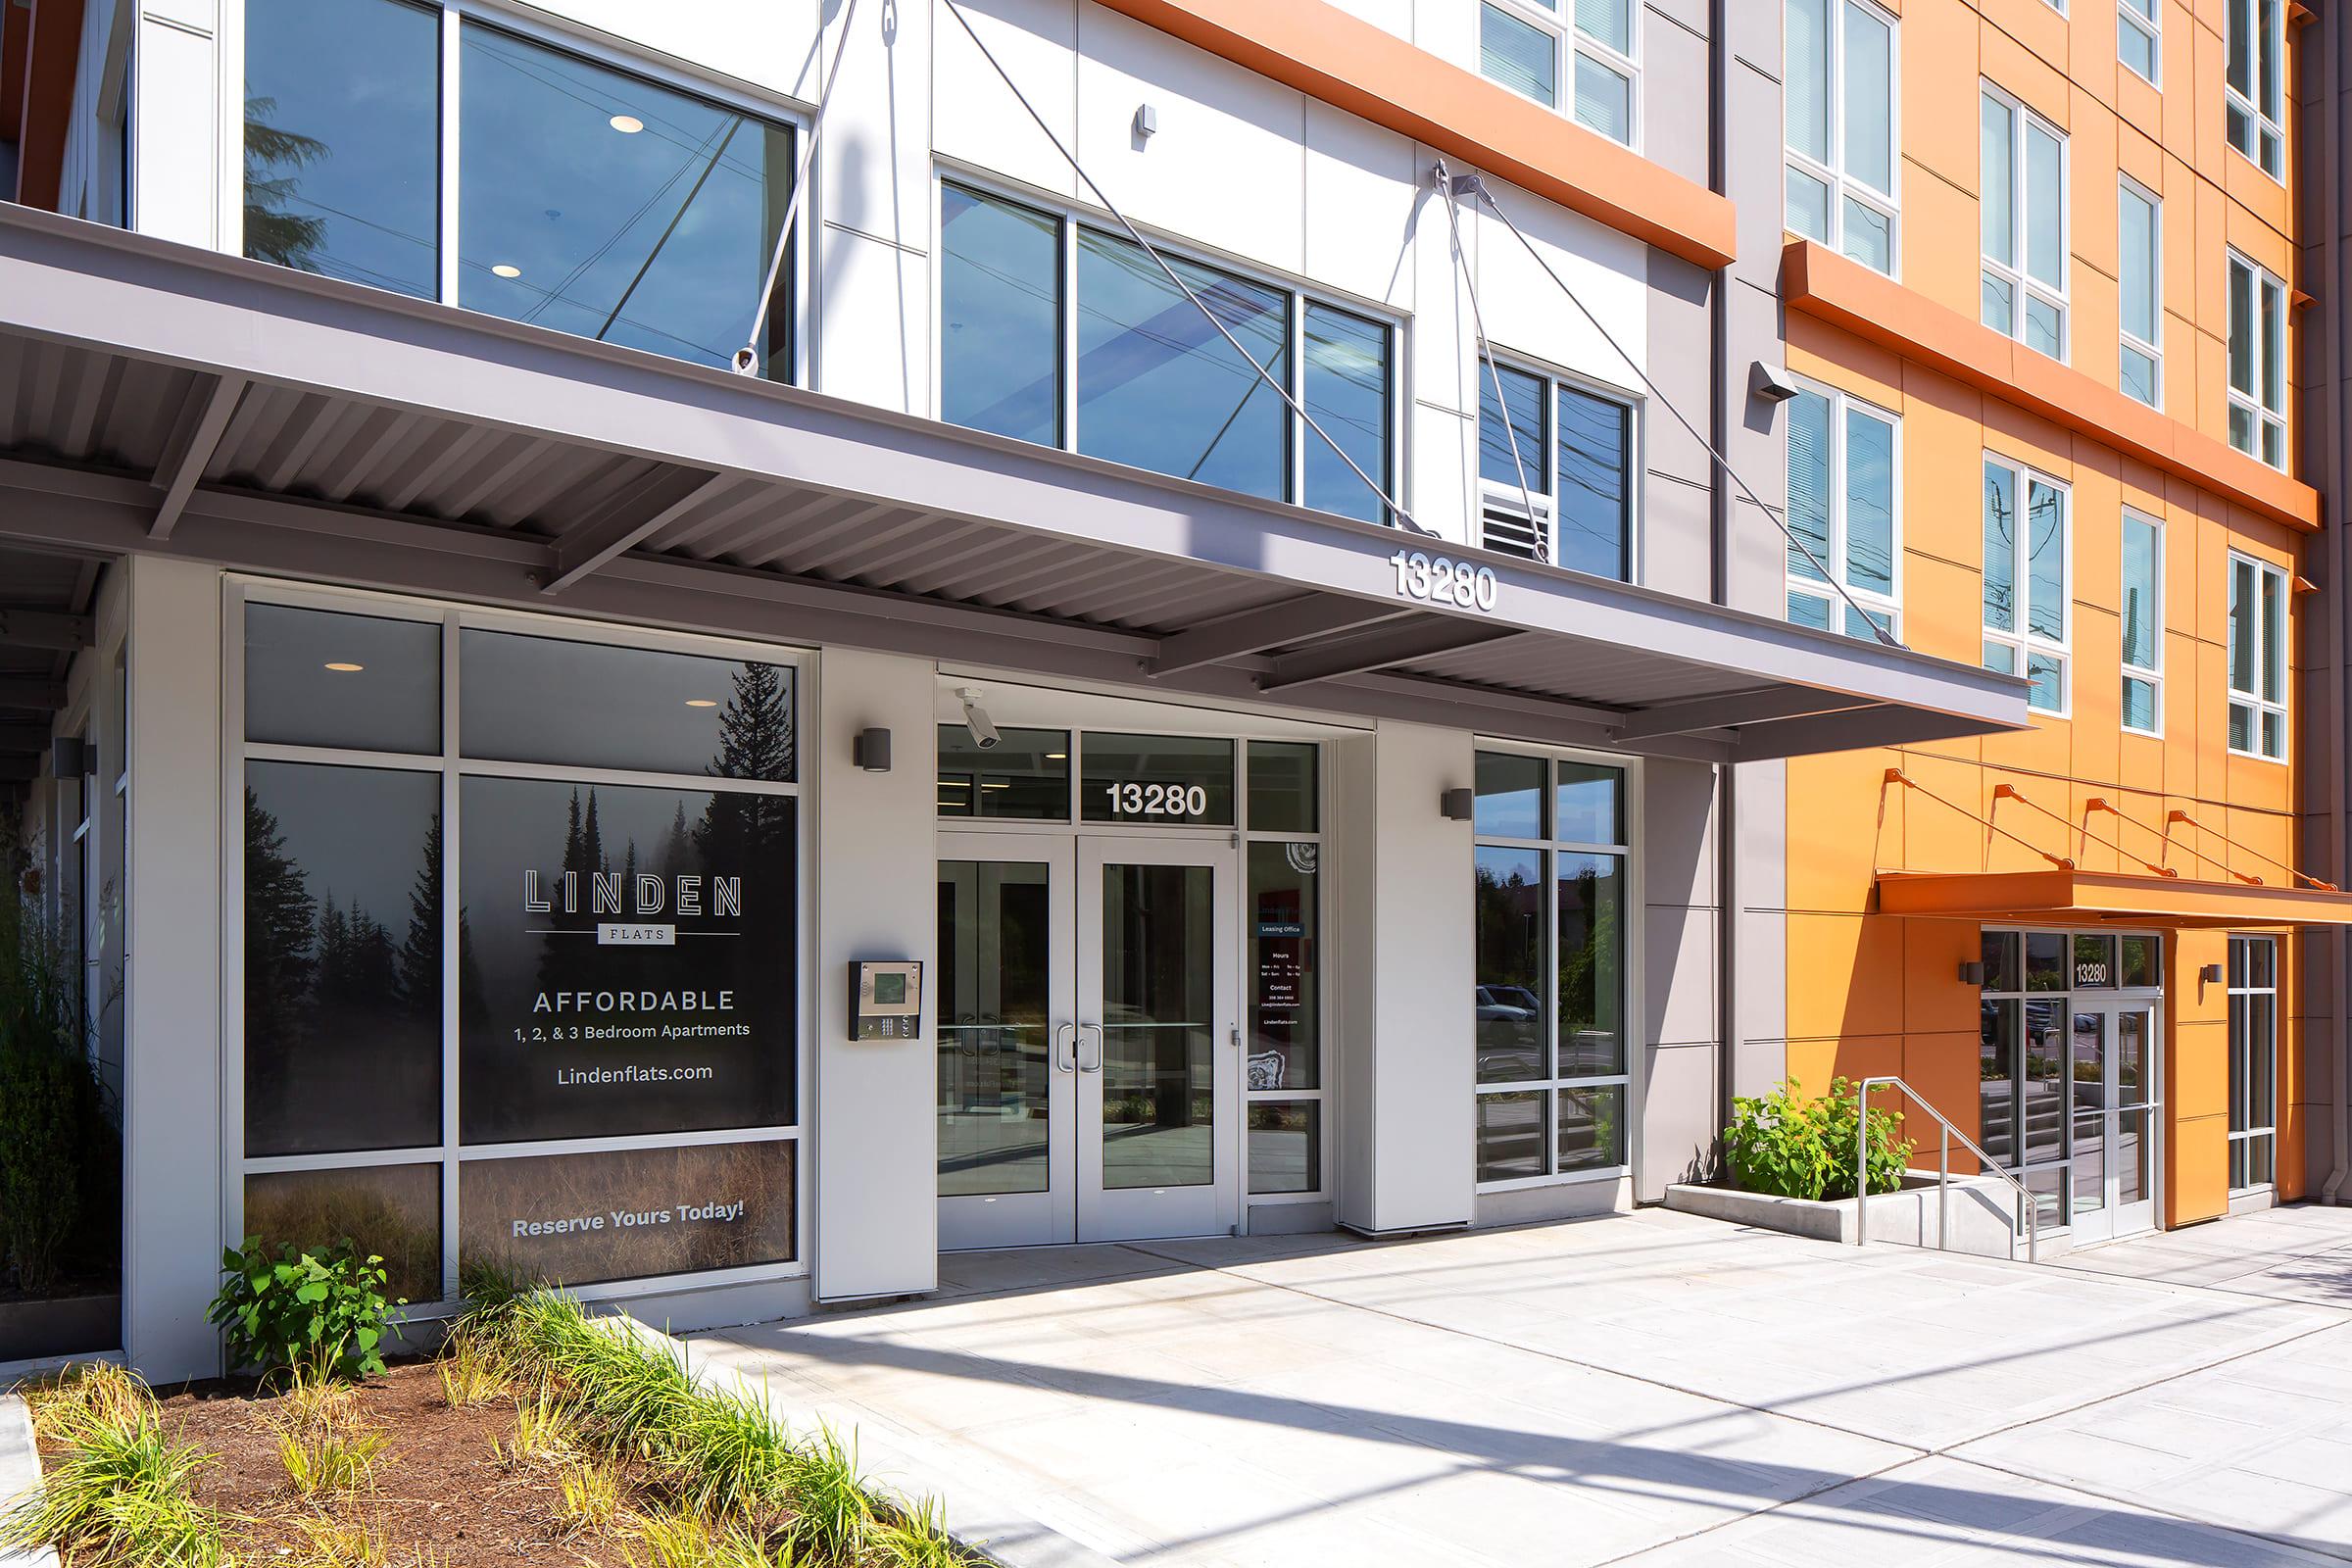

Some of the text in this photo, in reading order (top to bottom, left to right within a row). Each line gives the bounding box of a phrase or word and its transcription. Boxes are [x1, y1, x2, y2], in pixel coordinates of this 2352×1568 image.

[1389, 550, 1497, 612] 13280
[1105, 783, 1206, 815] 13280
[525, 869, 741, 916] LINDEN
[610, 929, 664, 940] FLATS
[1262, 925, 1283, 934] Leasing
[2077, 963, 2106, 983] 13280
[533, 991, 734, 1012] AFFORDABLE
[514, 1023, 750, 1042] 1, 2, & 3 Bedroom Apartments
[558, 1065, 712, 1085] Lindenflats.com
[513, 1200, 744, 1238] Reserve Yours Today!
